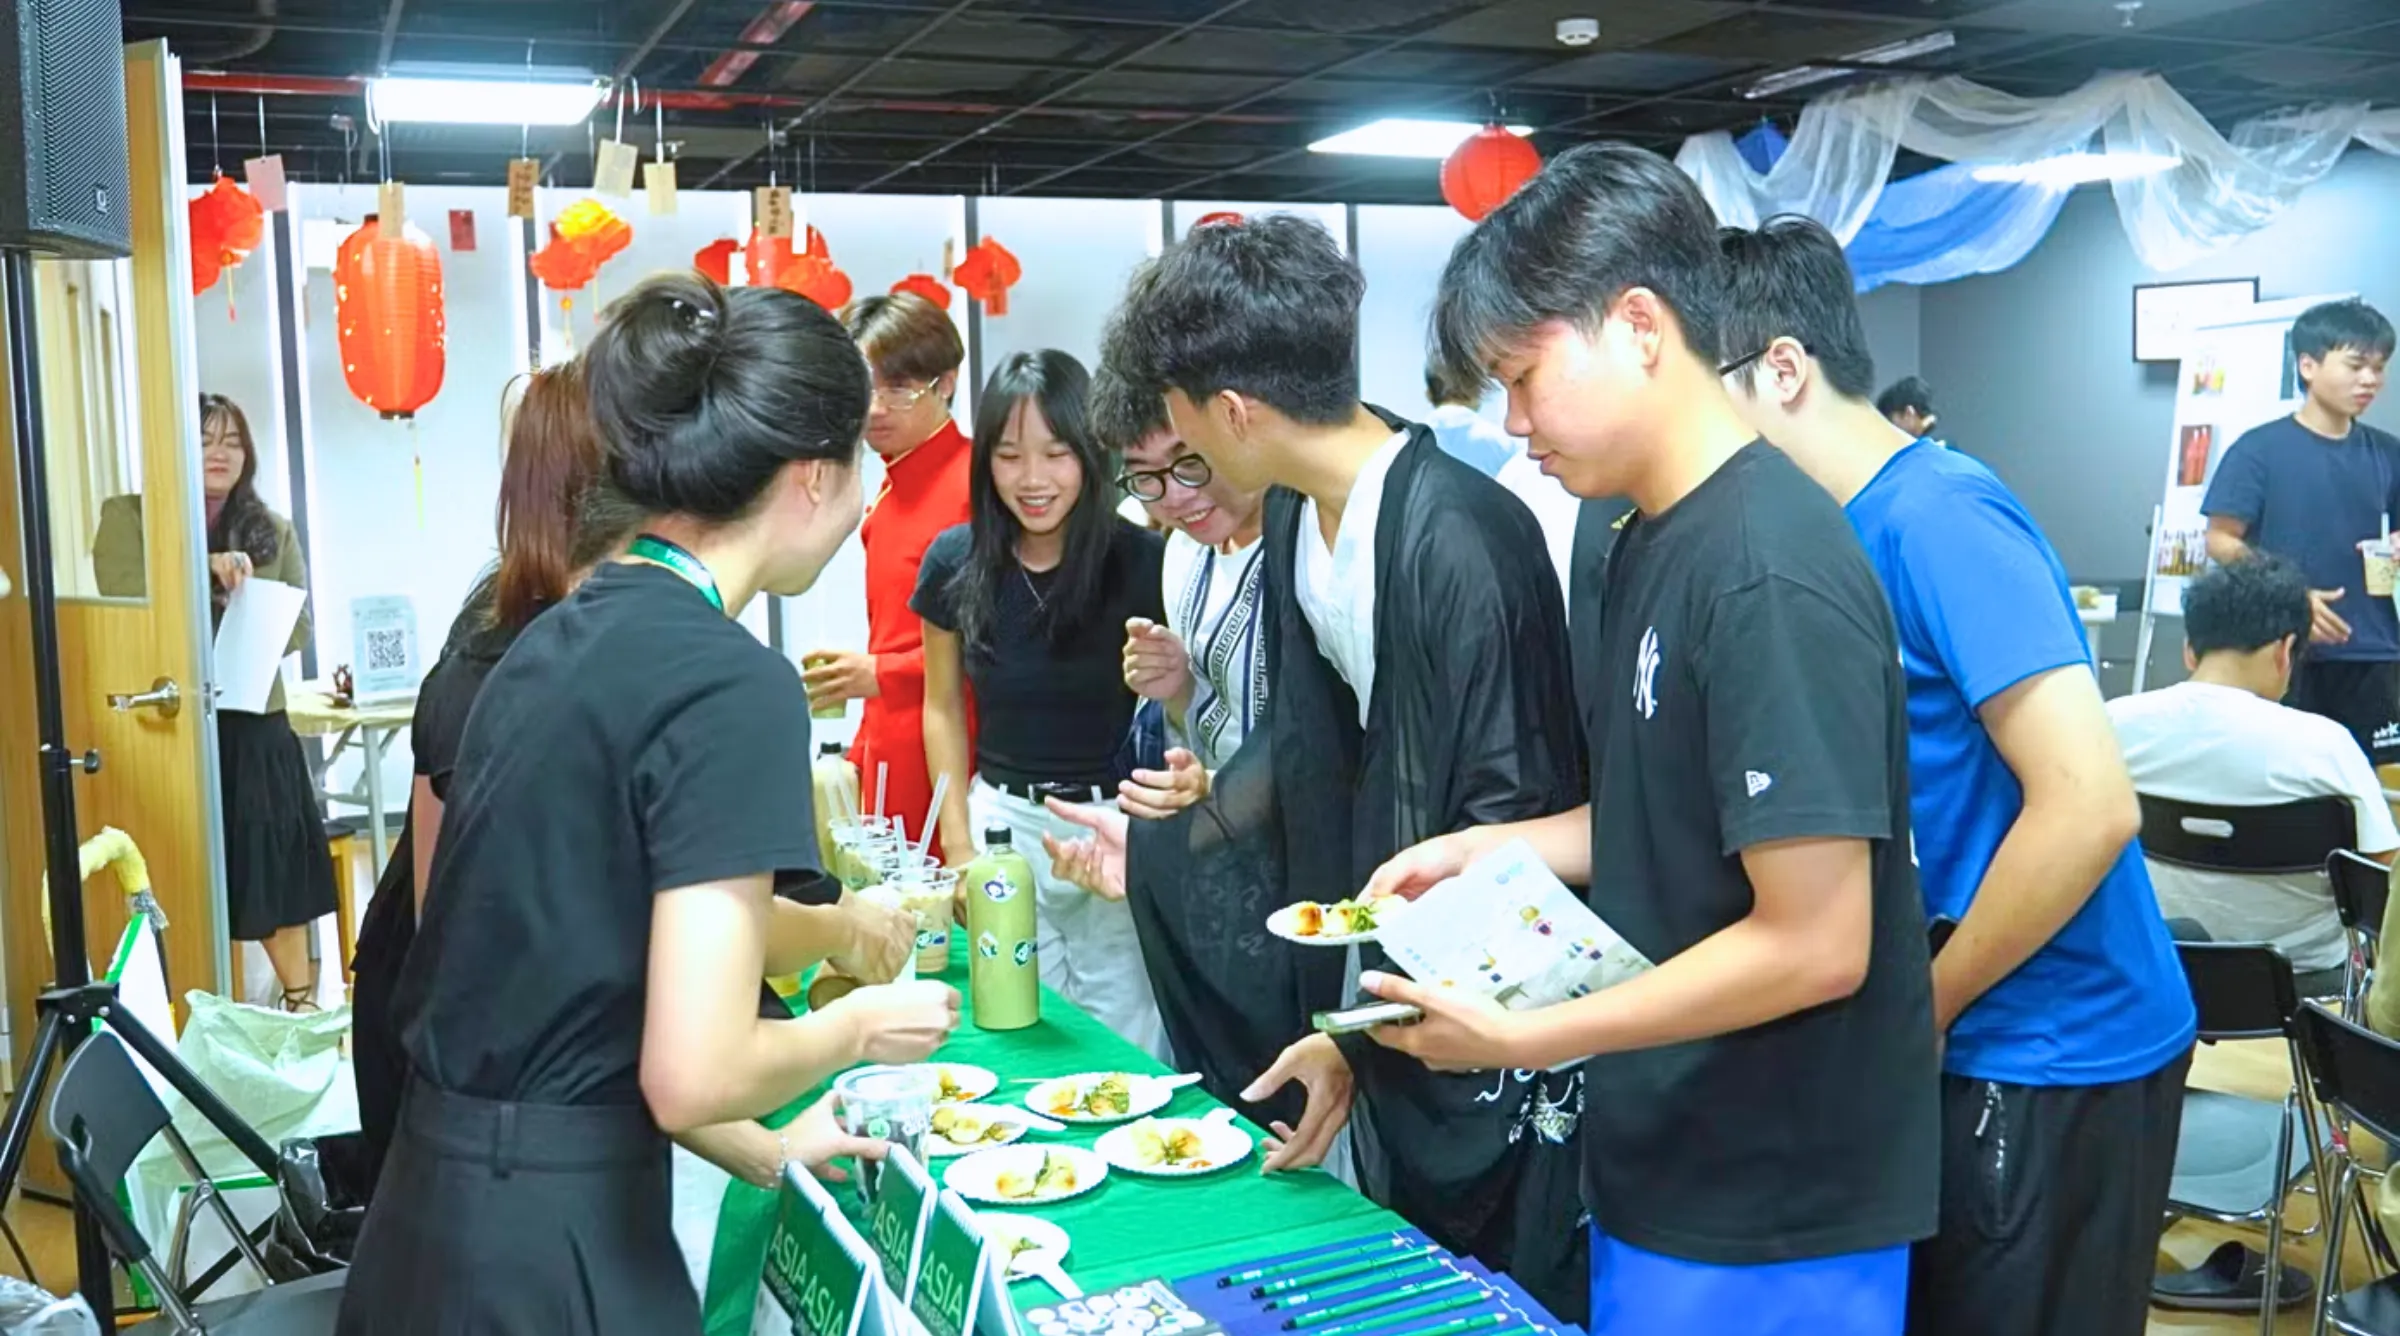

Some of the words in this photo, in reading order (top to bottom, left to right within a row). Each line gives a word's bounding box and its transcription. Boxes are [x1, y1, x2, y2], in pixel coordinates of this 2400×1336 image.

[769, 1222, 807, 1286] ASIA
[872, 1201, 909, 1272] ASIA
[801, 1274, 844, 1336] ASIA
[919, 1250, 963, 1329] ASIA
